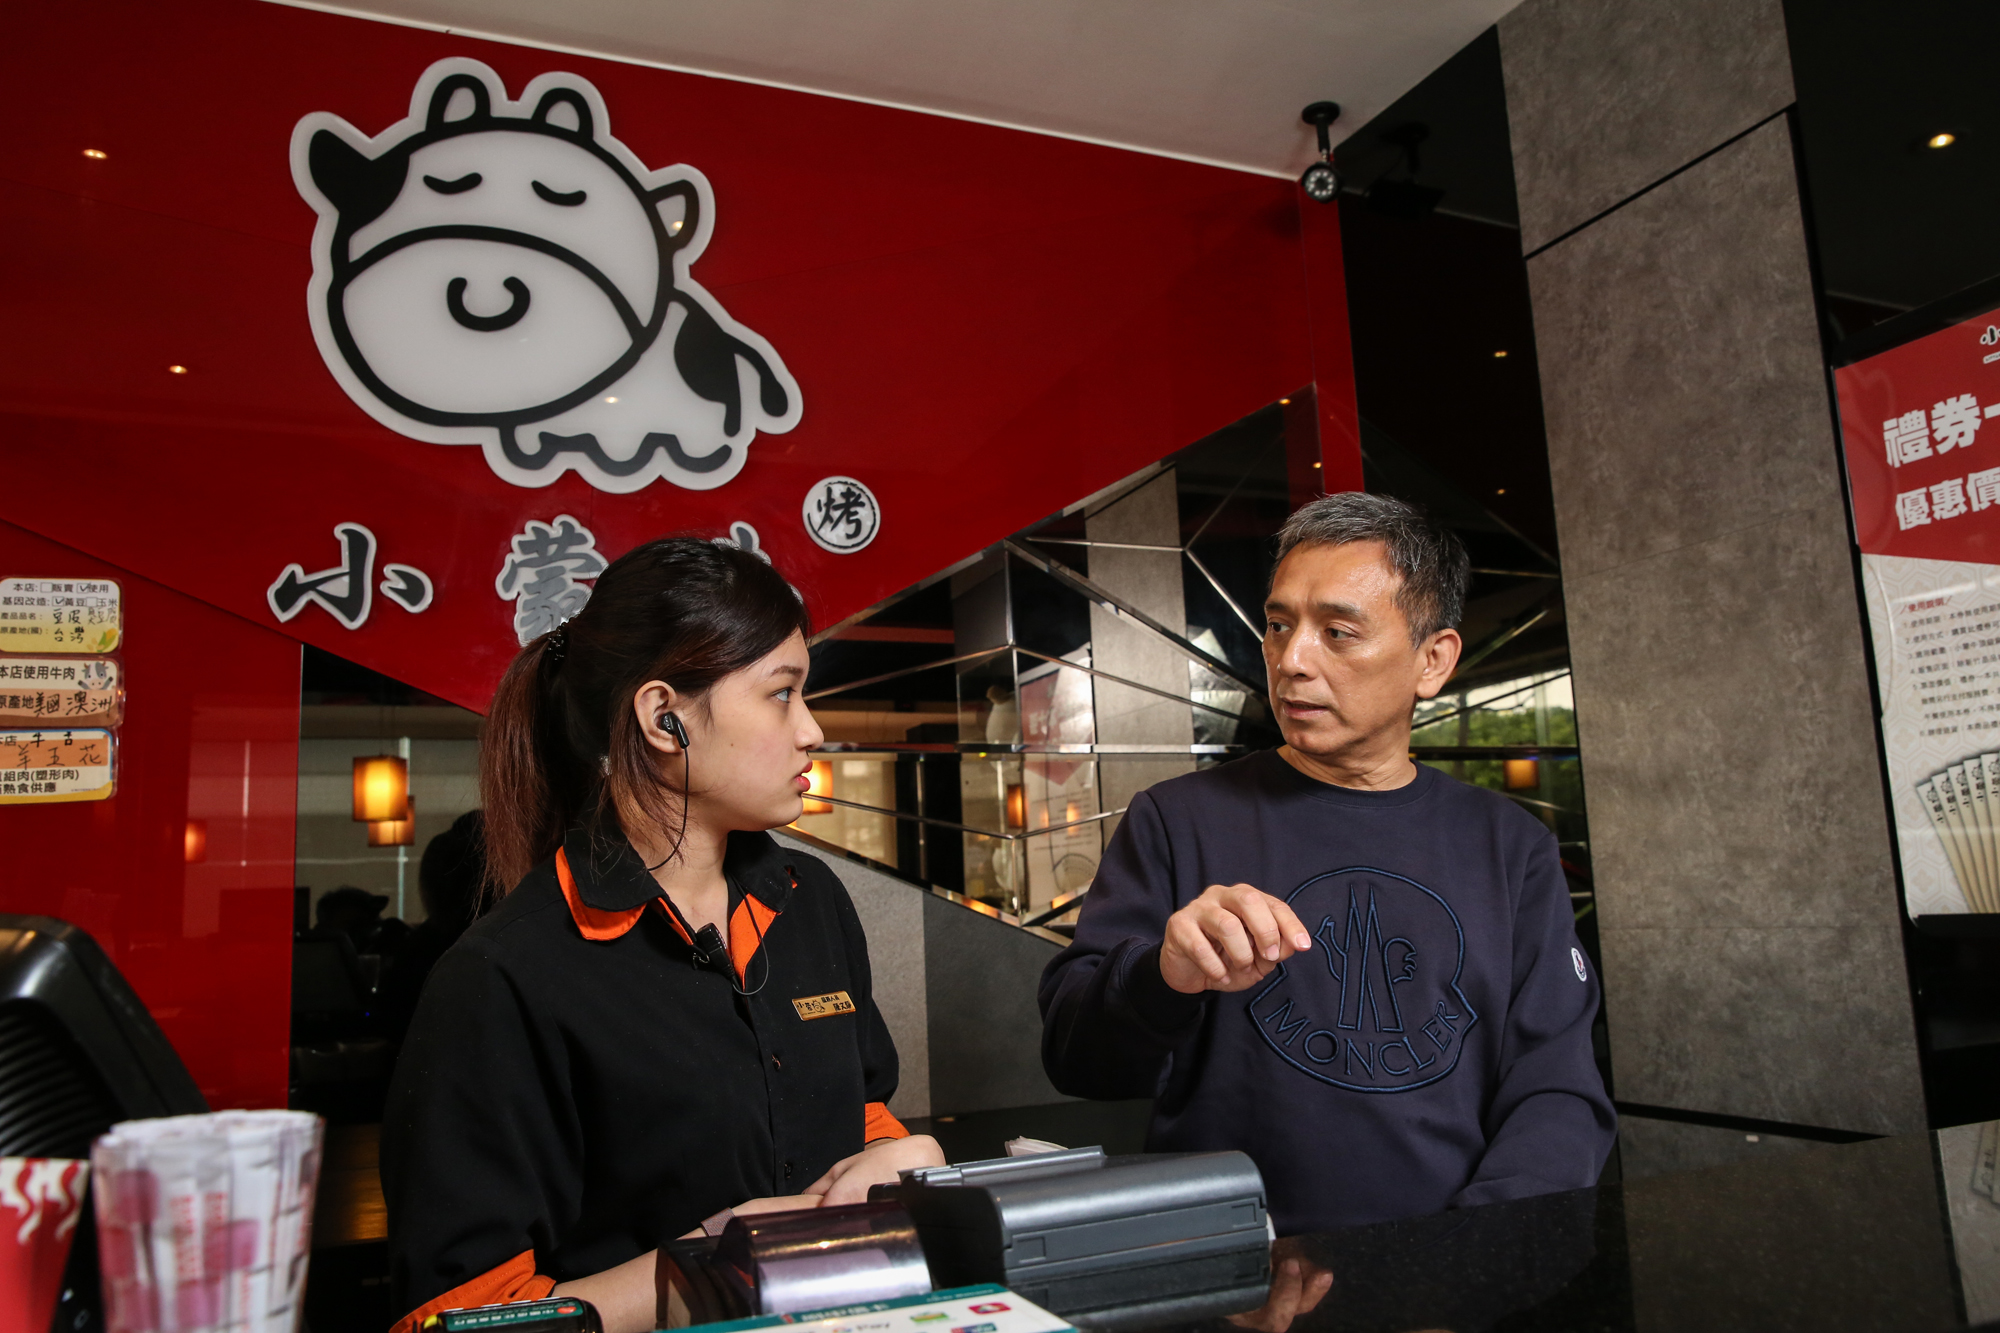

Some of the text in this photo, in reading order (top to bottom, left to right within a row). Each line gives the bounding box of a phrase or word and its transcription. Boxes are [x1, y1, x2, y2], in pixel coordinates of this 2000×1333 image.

[1895, 467, 2000, 531] 優惠價
[0, 665, 76, 680] 本店使用牛肉
[0, 769, 79, 781] 組肉(塑形肉)
[0, 782, 56, 795] 熟食供應
[1264, 1000, 1460, 1080] MONCLER
